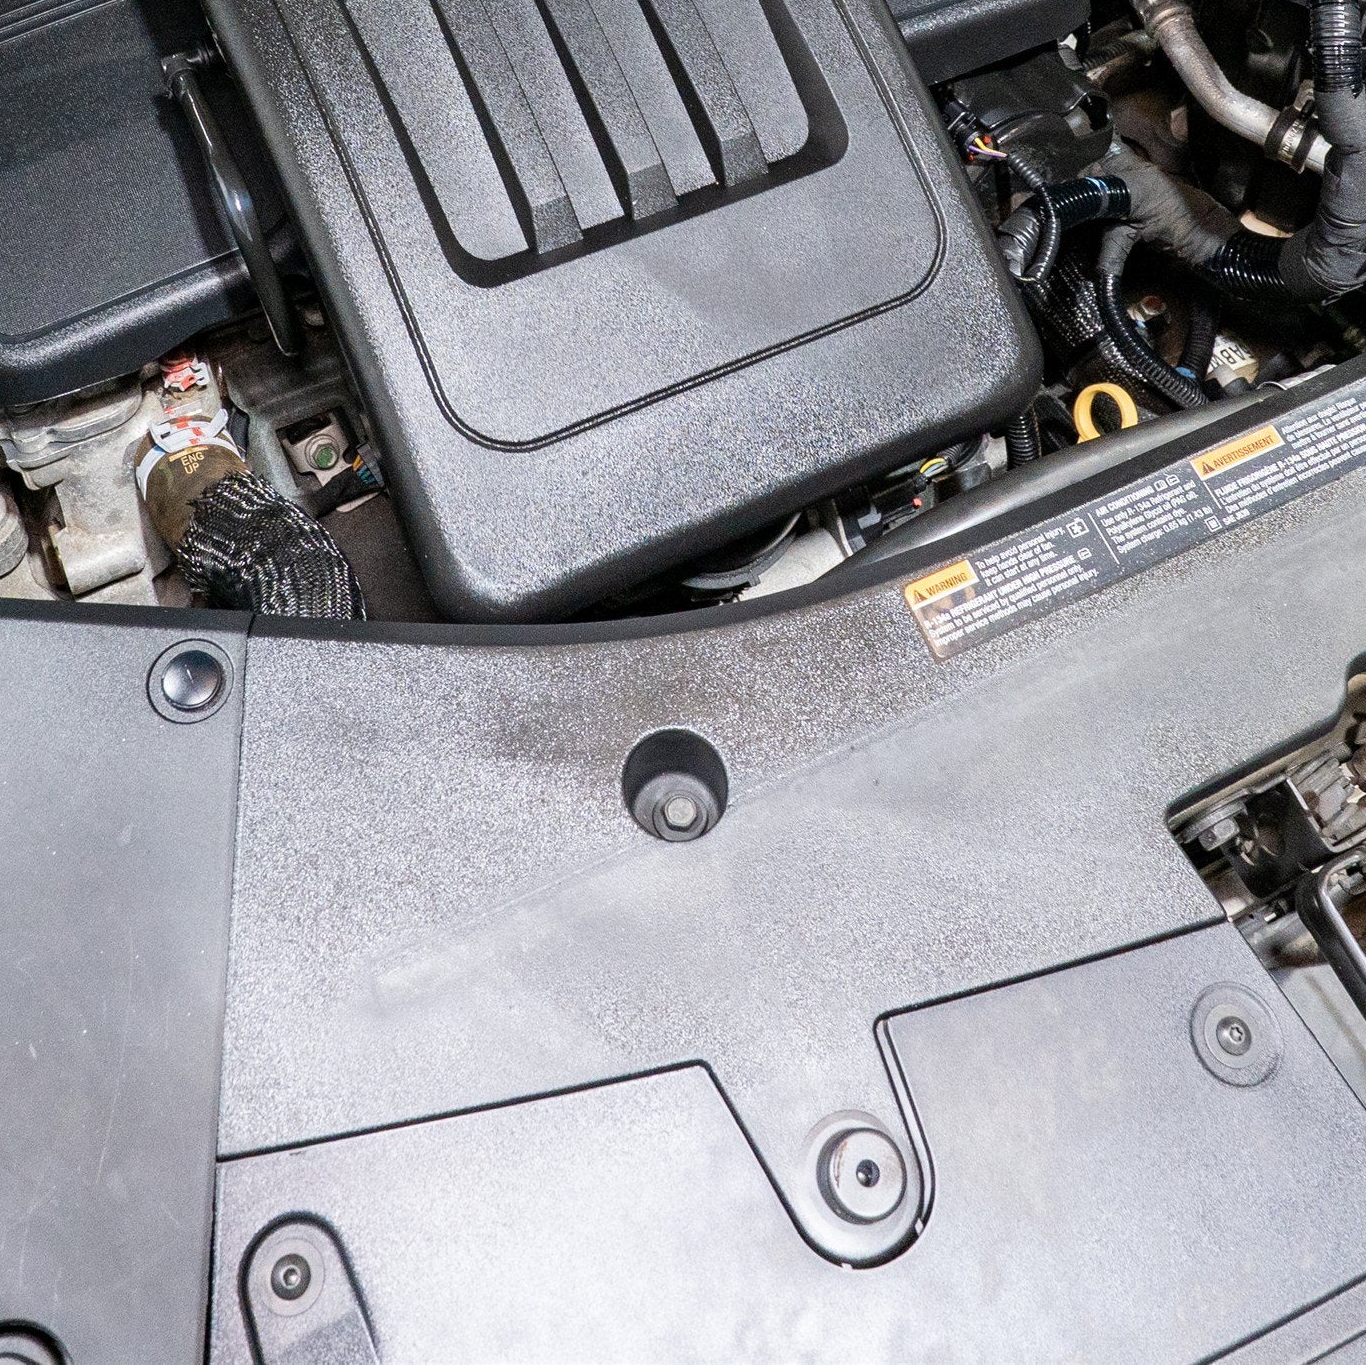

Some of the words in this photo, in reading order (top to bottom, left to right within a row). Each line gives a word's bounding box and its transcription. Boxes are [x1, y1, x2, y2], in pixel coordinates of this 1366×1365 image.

[181, 451, 205, 466] ENG
[1212, 435, 1275, 468] AVERTISSEMENT
[184, 463, 200, 475] UP
[1094, 506, 1109, 516] AIR
[1107, 486, 1155, 511] CONDITIONING
[1100, 516, 1115, 527] Use
[1113, 510, 1129, 522] only
[1126, 500, 1151, 515] R-134a
[1149, 485, 1185, 506] Refrigerant
[1182, 480, 1196, 490] and
[1143, 506, 1164, 520] Glycol
[1162, 502, 1172, 510] oil
[1170, 496, 1187, 508] (PAG
[1111, 534, 1125, 544] The
[1124, 524, 1148, 540] system
[1145, 512, 1173, 529] contains
[1116, 538, 1142, 554] System
[1139, 527, 1165, 544] charge:
[979, 565, 998, 579] keep
[996, 556, 1018, 570] hands
[1016, 549, 1033, 561] clear
[984, 554, 1000, 567] help
[999, 546, 1018, 559] avoid
[1016, 534, 1046, 552] personal
[991, 574, 1004, 583] can
[1002, 565, 1020, 578] start
[1027, 558, 1041, 568] any
[1039, 549, 1057, 561] time.
[926, 572, 968, 596] WARNING
[949, 590, 999, 617] REFRIGERANT
[997, 579, 1023, 596] UNDER
[1021, 571, 1041, 584] HIGH
[1038, 555, 1076, 577] PRESSURE
[933, 628, 966, 648] Improper
[964, 617, 989, 633] service
[987, 604, 1018, 622] methods
[1017, 599, 1033, 610] may
[1031, 590, 1052, 602] cause
[1050, 576, 1080, 595] personal
[970, 600, 1000, 618] serviced
[1007, 584, 1038, 603] qualified
